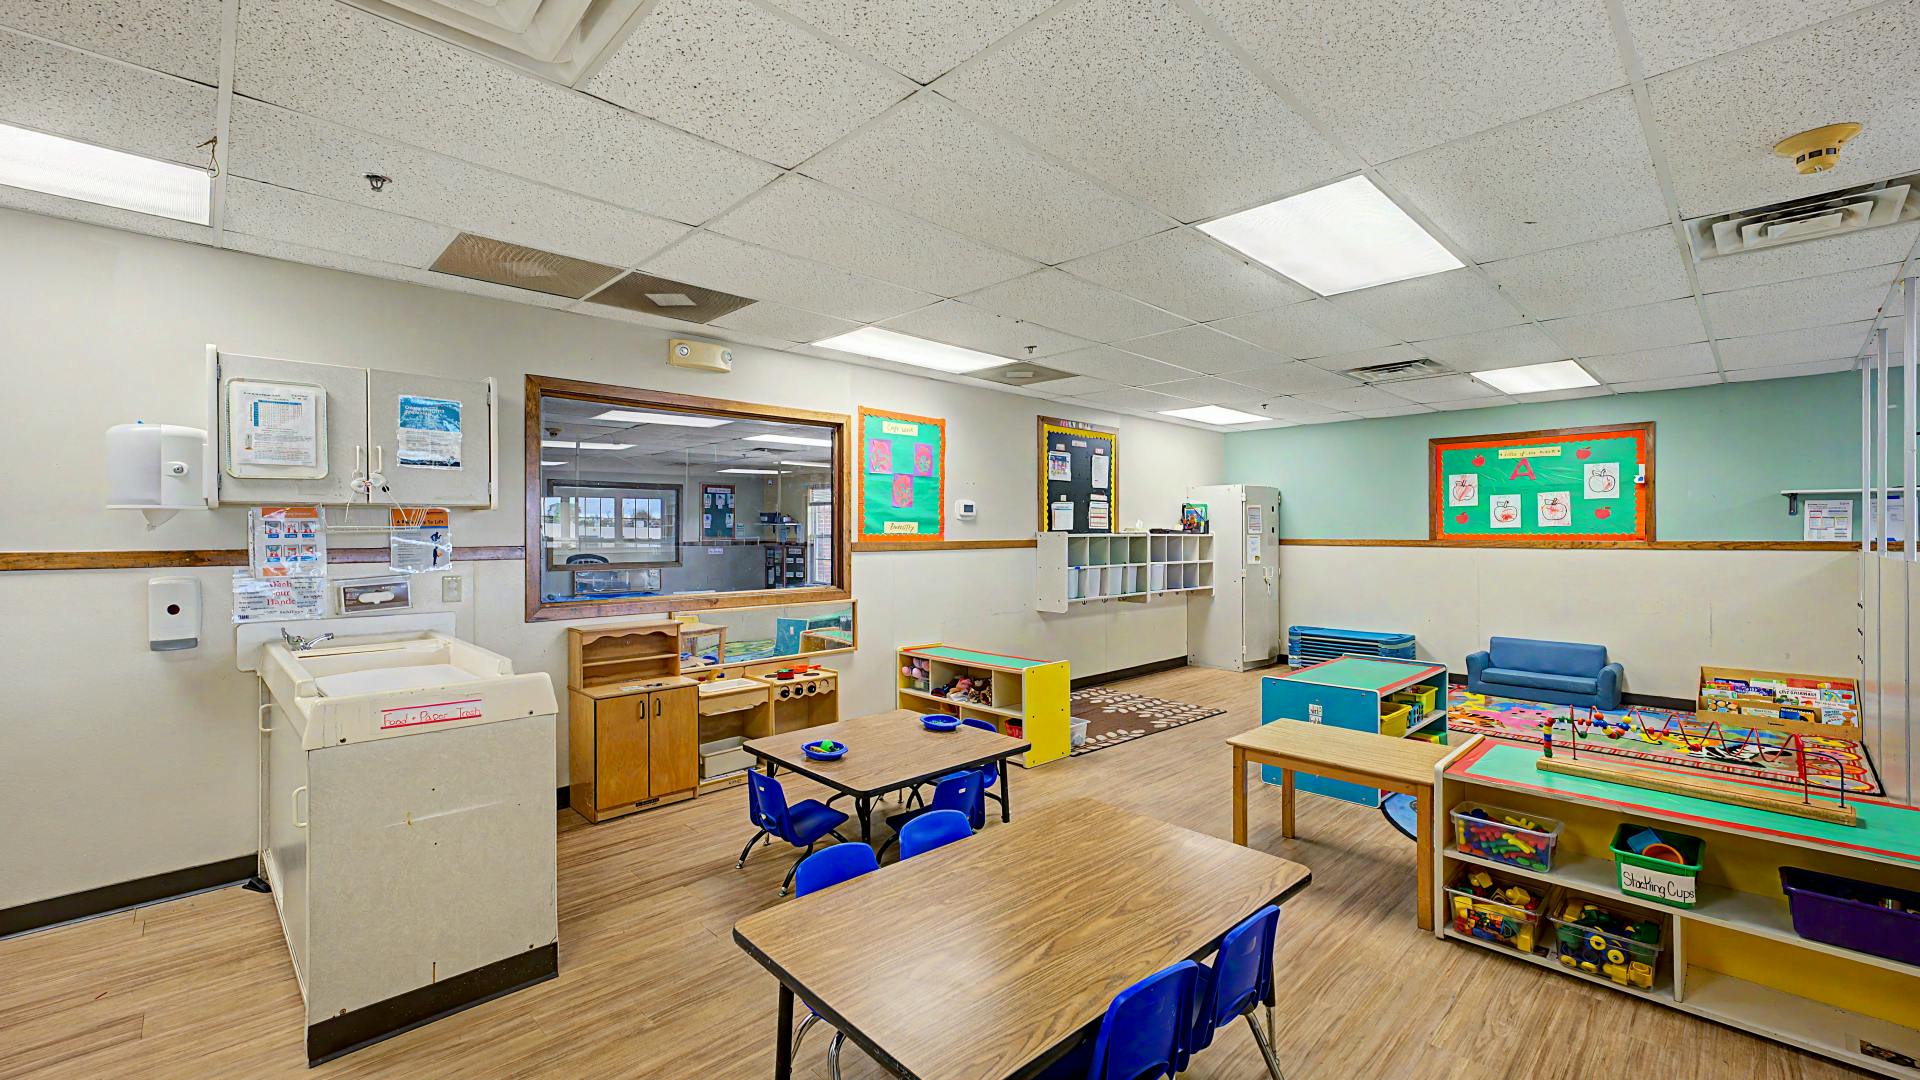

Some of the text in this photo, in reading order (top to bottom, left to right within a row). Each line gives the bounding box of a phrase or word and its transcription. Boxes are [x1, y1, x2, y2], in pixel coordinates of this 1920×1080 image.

[1509, 457, 1536, 480] A
[383, 713, 409, 727] Food
[419, 709, 449, 721] Paper
[455, 706, 481, 719] Trash
[1623, 871, 1695, 903] Stacking Cups
